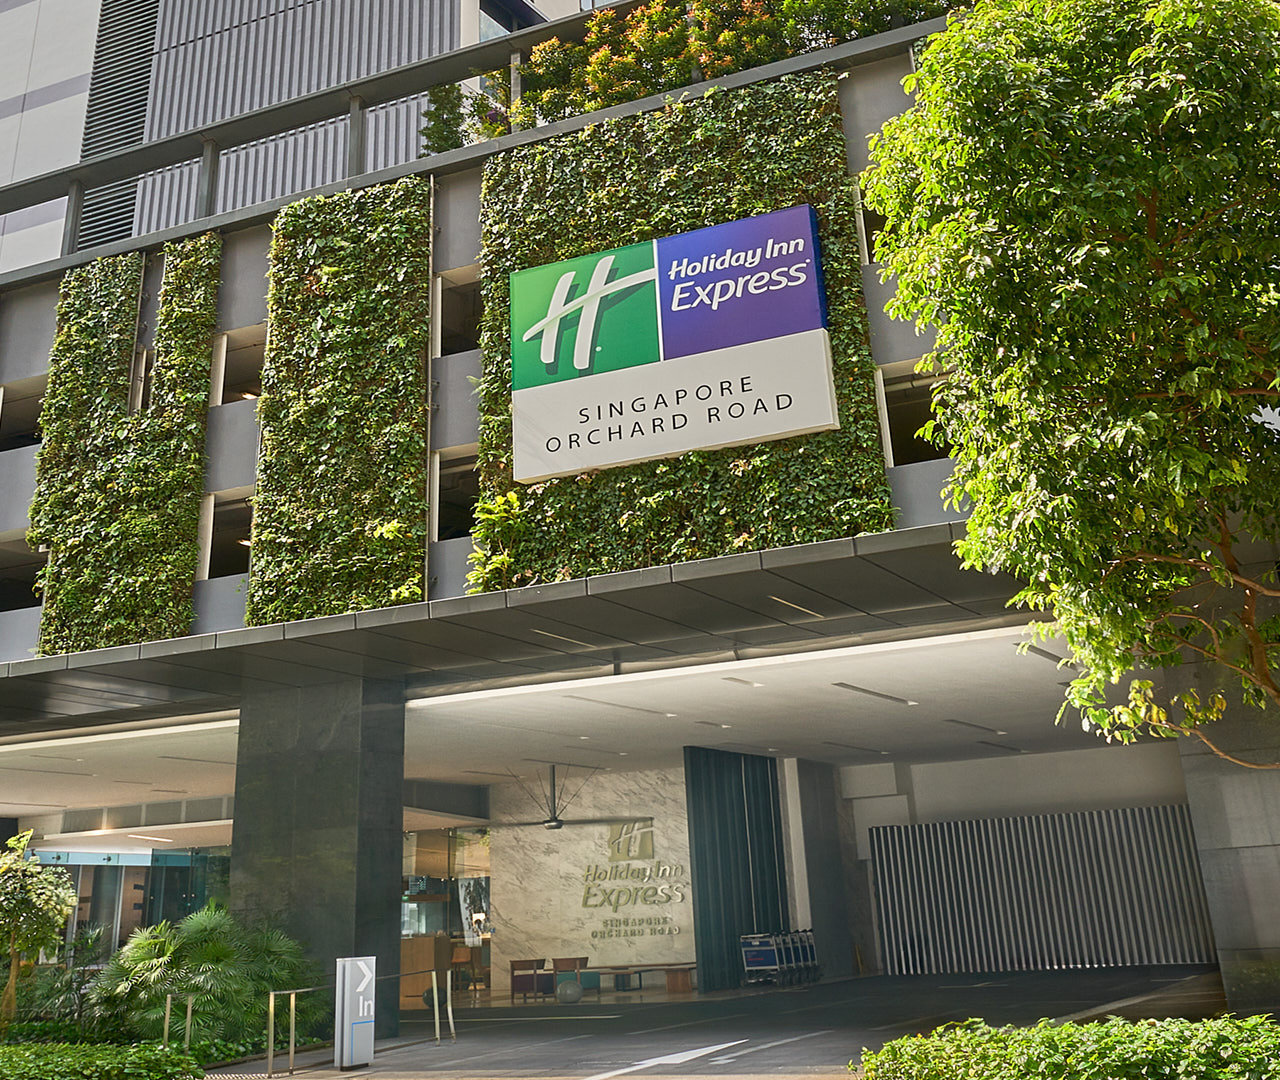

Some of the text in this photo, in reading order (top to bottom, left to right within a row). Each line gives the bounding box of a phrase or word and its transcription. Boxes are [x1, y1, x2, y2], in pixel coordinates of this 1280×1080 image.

[668, 237, 805, 280] Holiday Inn
[670, 263, 808, 311] Express
[578, 375, 754, 424] SINGAPORE
[545, 393, 794, 453] ORCHARD ROAD
[584, 861, 684, 883] Holiday Inn
[582, 884, 686, 913] Express
